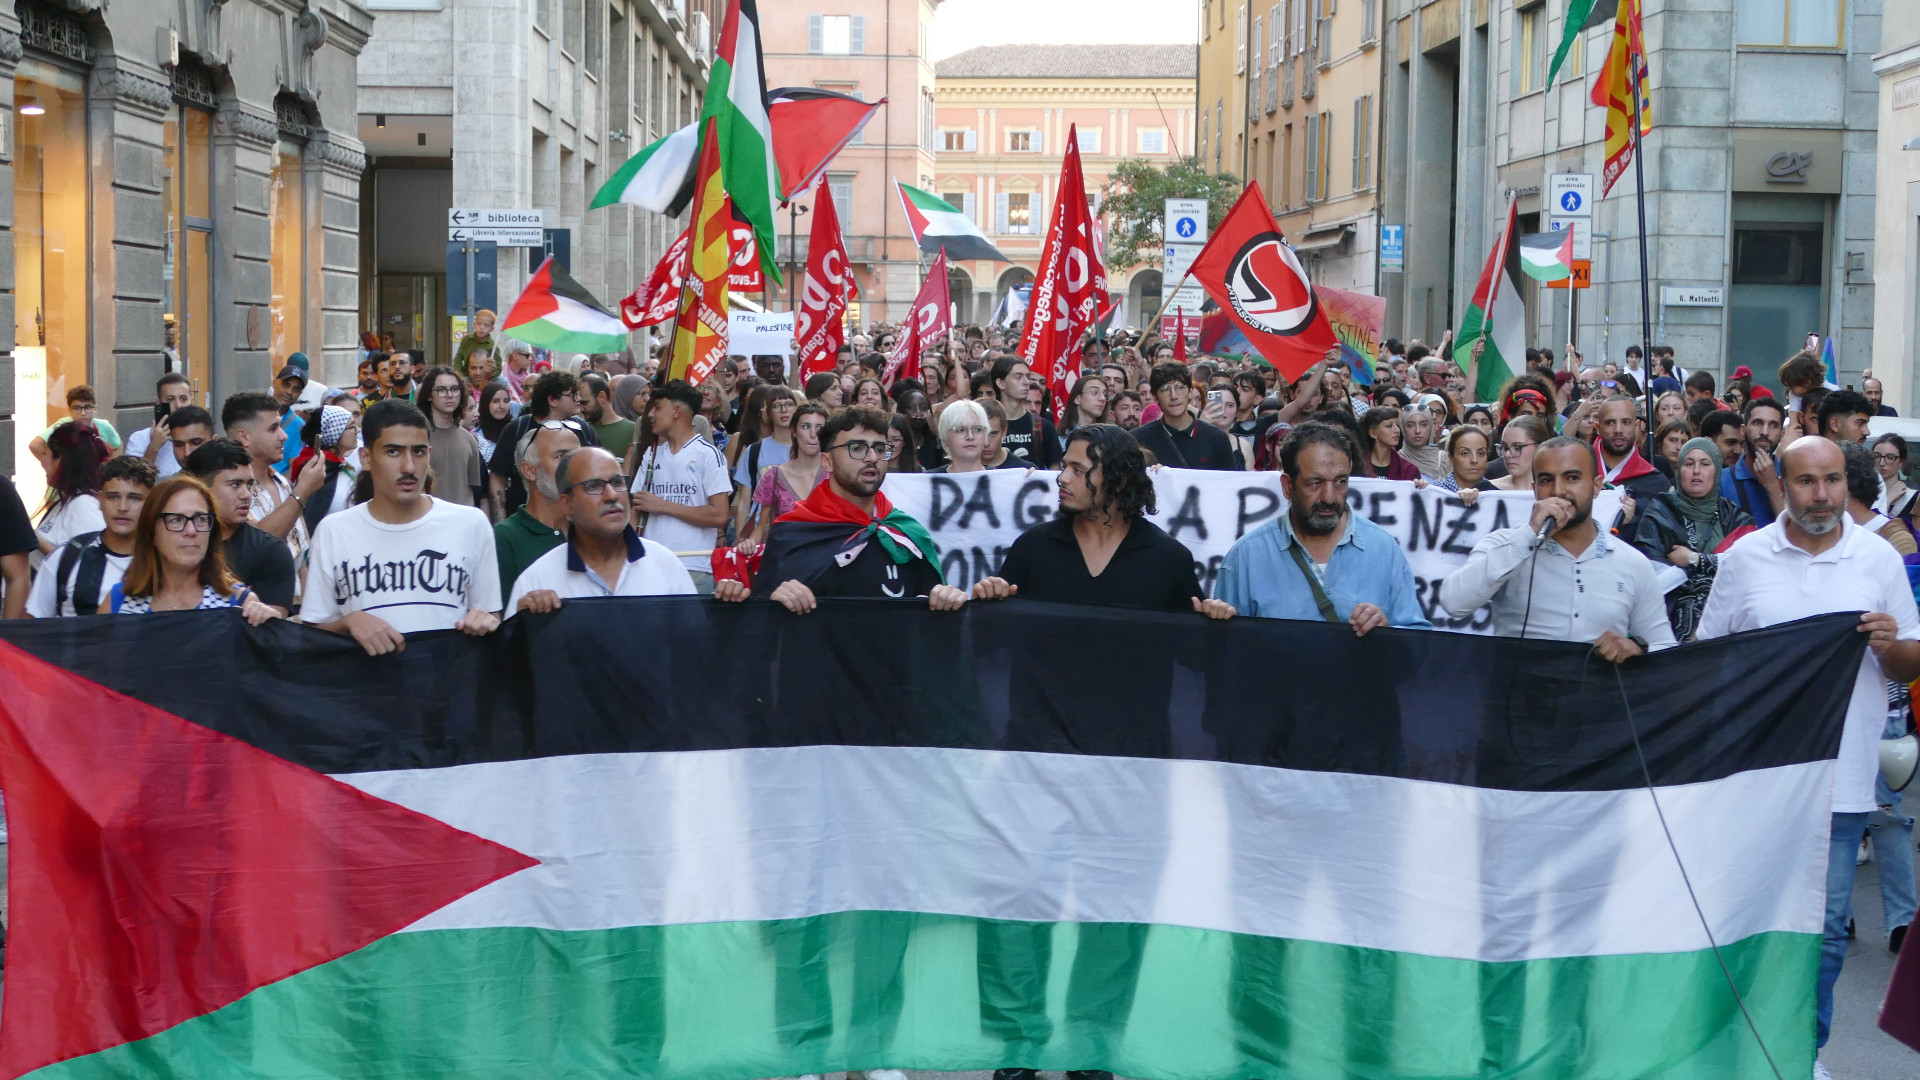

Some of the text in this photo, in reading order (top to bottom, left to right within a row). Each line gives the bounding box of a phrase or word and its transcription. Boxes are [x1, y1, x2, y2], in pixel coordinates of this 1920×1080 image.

[488, 213, 541, 223] biblioteca
[1689, 295, 1720, 303] Matteotti
[1224, 282, 1273, 335] ANTIFASCISTA
[736, 315, 758, 324] FREE
[755, 323, 794, 333] PALESTINE
[928, 474, 1001, 531] DA
